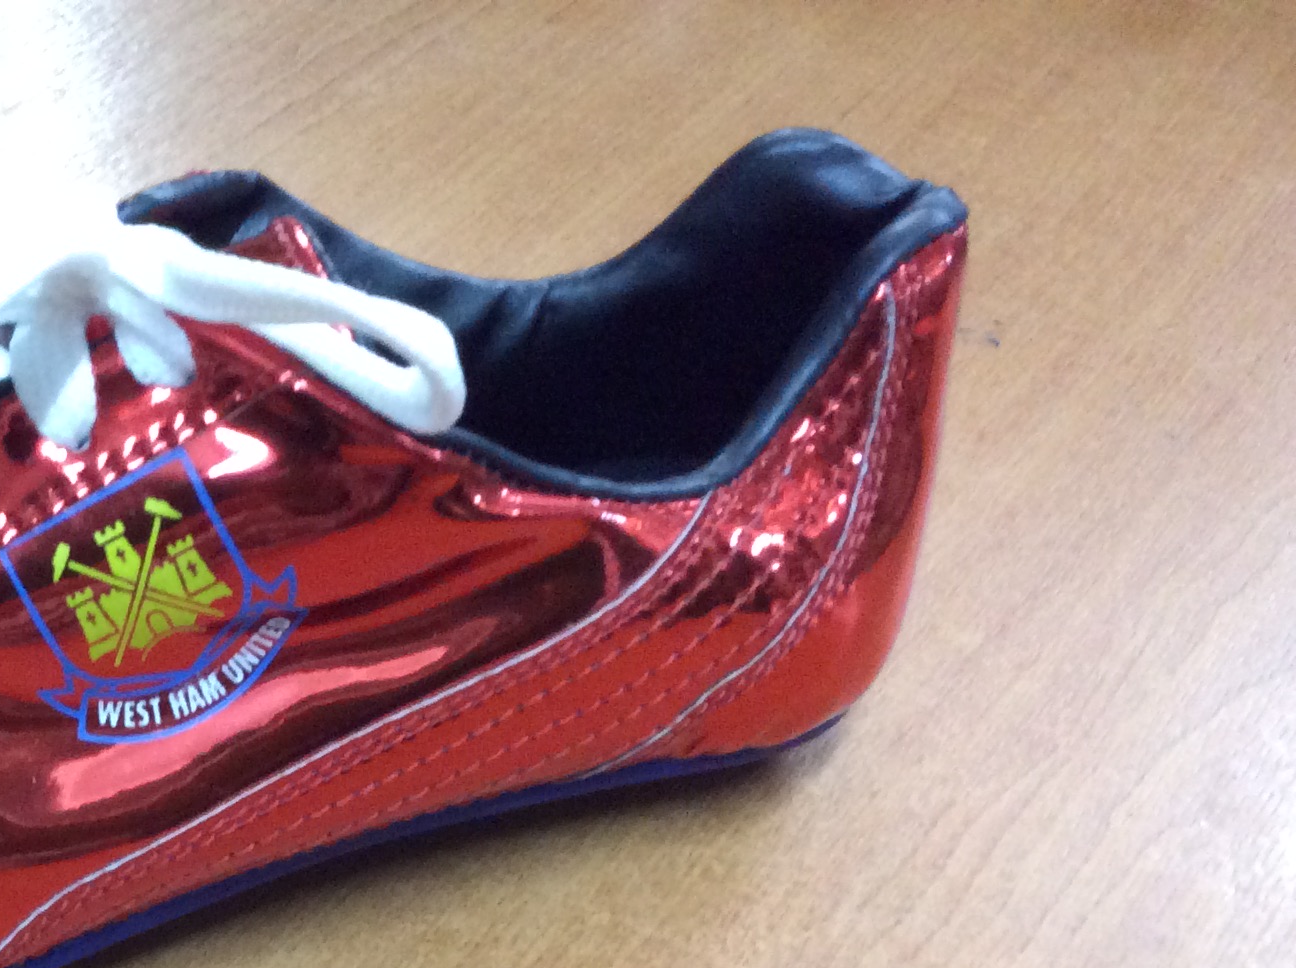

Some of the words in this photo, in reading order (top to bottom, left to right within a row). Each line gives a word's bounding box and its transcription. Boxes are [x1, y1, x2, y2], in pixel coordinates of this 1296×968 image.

[97, 696, 163, 728] WEST
[168, 670, 227, 720] HAM
[221, 616, 292, 685] UNITED
